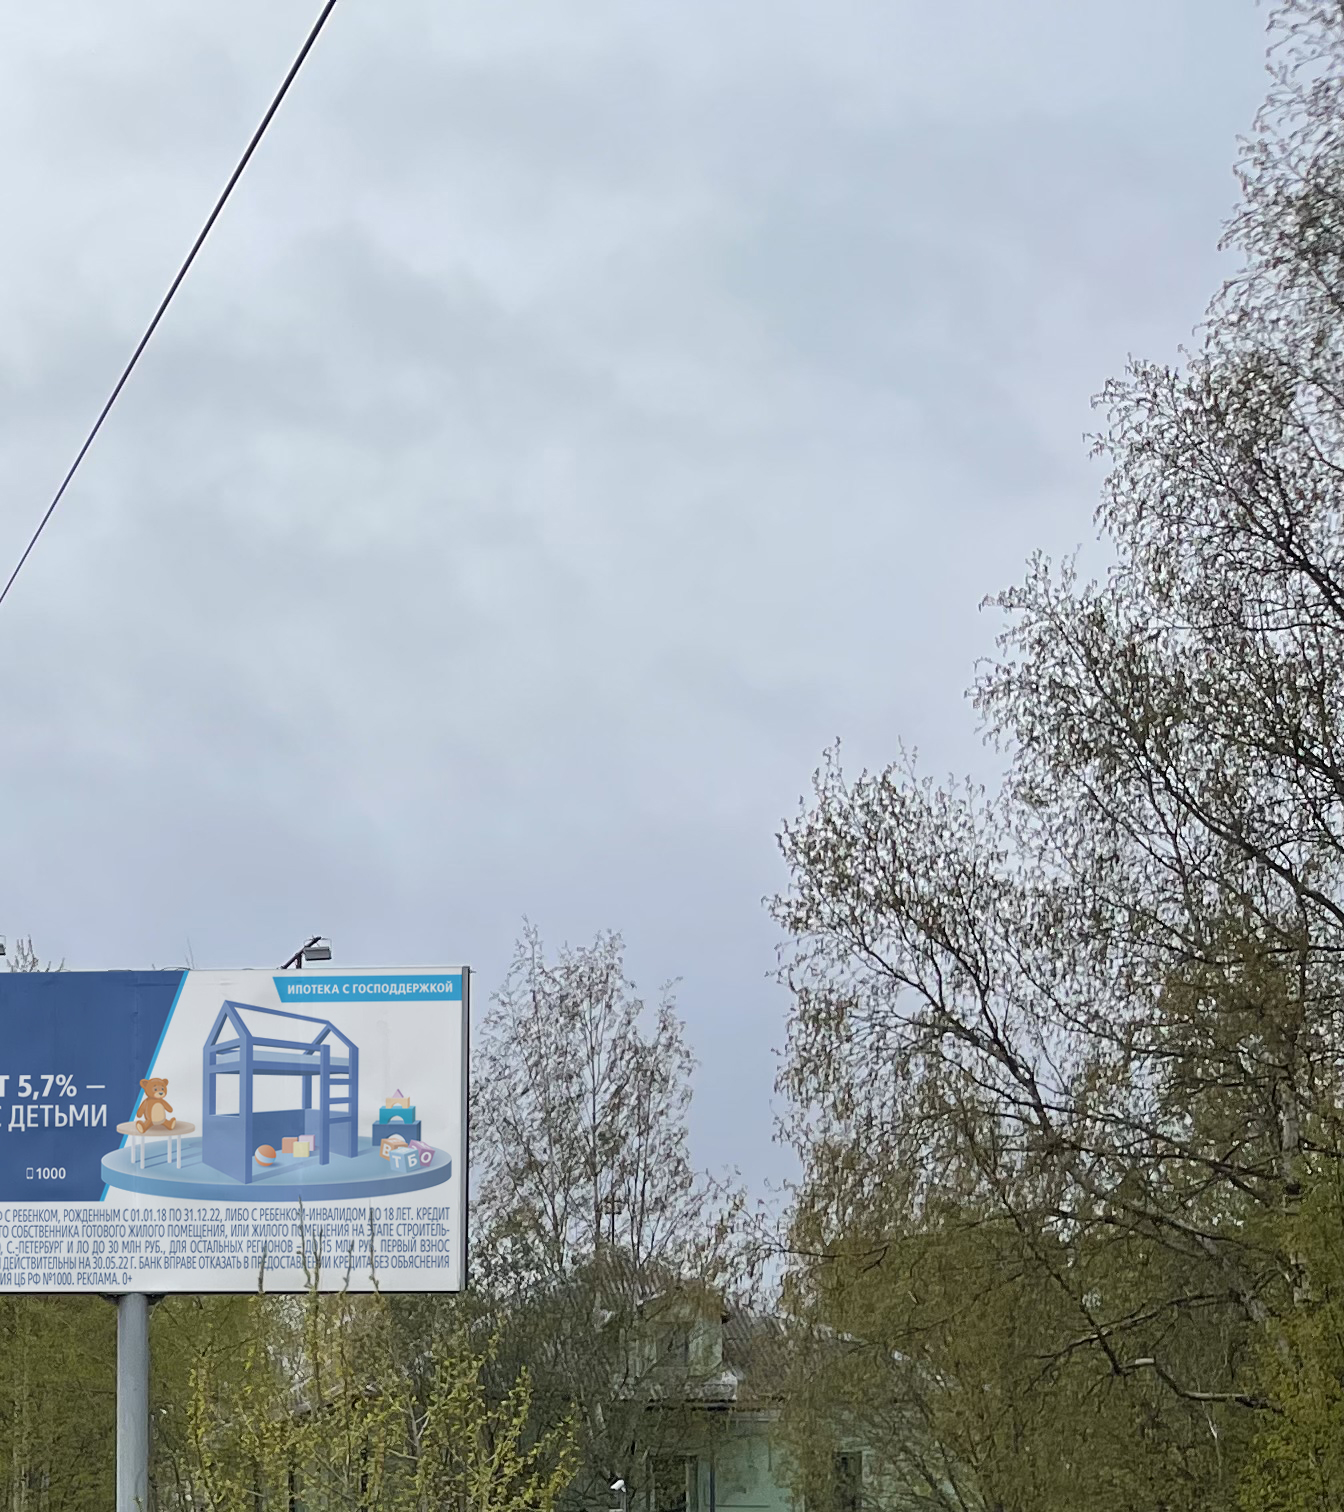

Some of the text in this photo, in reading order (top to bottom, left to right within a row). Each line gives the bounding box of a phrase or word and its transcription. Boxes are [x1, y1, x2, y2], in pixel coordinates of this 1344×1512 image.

[287, 980, 453, 995] ИПОТЕКА С ГОСПОДДЕРЖКОЙ
[17, 1073, 77, 1100] 5,7%
[8, 1104, 108, 1132] ДЕТЬМИ
[36, 1167, 66, 1179] 1000
[4, 1209, 11, 1222] С
[12, 1209, 61, 1224] РЕБЕНКОМ,
[63, 1209, 121, 1224] РОЖДЕННЫМ
[122, 1208, 129, 1221] С
[130, 1208, 167, 1221] 01.01.18
[169, 1208, 182, 1221] ПО
[183, 1208, 223, 1223] 31.12.22,
[224, 1208, 250, 1221] ЛИБО
[251, 1208, 258, 1221] С
[383, 1207, 395, 1220] 18
[395, 1207, 414, 1220] ЛЕТ.
[416, 1207, 450, 1222] КРЕДИТ
[11, 1225, 80, 1237] СОБСТВЕННИКА
[81, 1225, 127, 1237] ГОТОВОГО
[127, 1224, 166, 1237] ЖИЛОГО
[167, 1224, 228, 1239] ПОМЕЩЕНИЯ,
[230, 1224, 250, 1237] ИЛИ
[251, 1224, 290, 1237] ЖИЛОГО
[351, 1224, 366, 1236] НА
[396, 1223, 450, 1236] СТРОИТЕЛЬ-
[6, 1241, 64, 1253] С.-ПЕТЕРБУРГ
[66, 1241, 74, 1253] И
[75, 1240, 90, 1253] ЛО
[91, 1240, 106, 1255] ДО
[108, 1240, 120, 1253] 30
[121, 1240, 142, 1253] МЛН
[144, 1240, 166, 1255] РУБ.,
[168, 1240, 187, 1255] ДЛЯ
[189, 1240, 244, 1253] ОСТАЛЬНЫХ
[380, 1236, 417, 1252] ПЕРВЫЙ
[419, 1239, 450, 1252] ВЗНОС
[3, 1253, 77, 1271] ДЕЙСТВИТЕЛЬНЫ
[78, 1256, 92, 1269] НА
[93, 1256, 129, 1269] 30.05.22
[130, 1256, 137, 1269] Г.
[138, 1256, 163, 1269] БАНК
[164, 1256, 197, 1269] ВПРАВЕ
[198, 1256, 243, 1269] ОТКАЗАТЬ
[243, 1256, 250, 1269] В
[333, 1255, 373, 1270] КРЕДИТА
[374, 1255, 390, 1268] БЕЗ
[390, 1255, 450, 1268] ОБЪЯСНЕНИЯ
[14, 1272, 26, 1287] ЦБ
[27, 1272, 42, 1285] РФ
[42, 1272, 75, 1285] №1000.
[76, 1272, 121, 1285] РЕКЛАМА.
[121, 1272, 133, 1285] 0+
